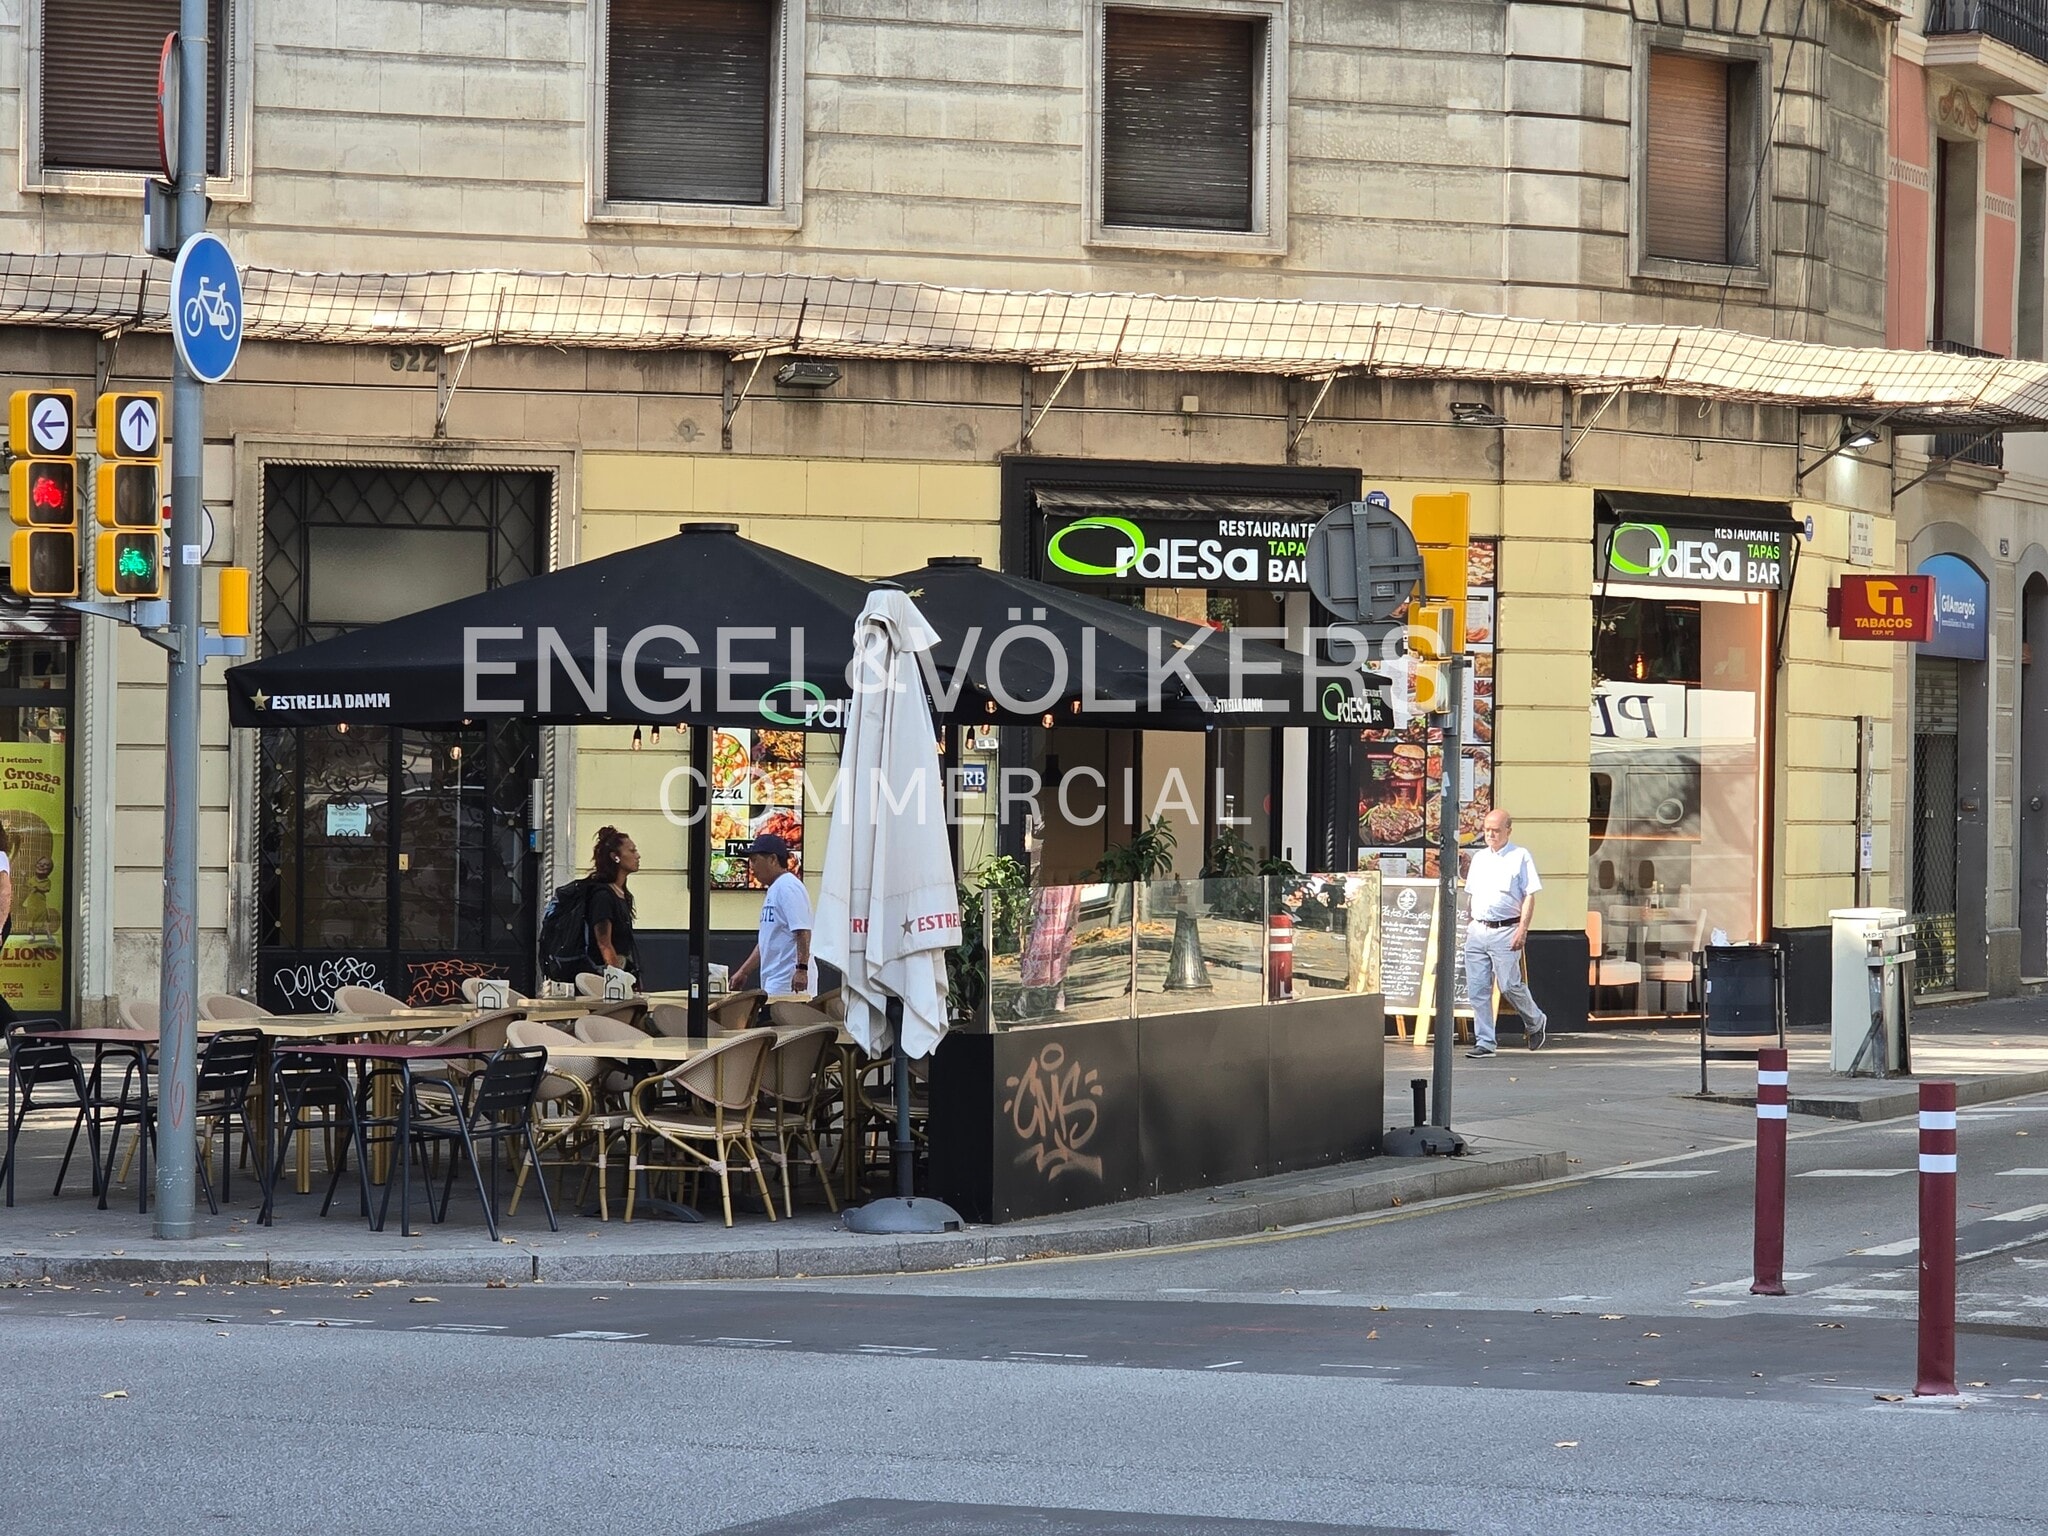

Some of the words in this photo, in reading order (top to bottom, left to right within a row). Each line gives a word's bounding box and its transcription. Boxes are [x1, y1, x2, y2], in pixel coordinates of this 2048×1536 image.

[389, 345, 437, 372] 522
[1715, 527, 1781, 543] RESTAURANTE
[1268, 541, 1307, 557] TAPA
[1747, 543, 1780, 560] TAPAS
[1747, 562, 1780, 585] BAR
[1854, 617, 1913, 629] TABACOS
[272, 694, 343, 710] ESTRELLA
[345, 693, 391, 709] DAMM
[6, 756, 43, 764] setembre
[4, 767, 62, 786] Grossa
[4, 781, 19, 790] La
[21, 780, 55, 794] Diada
[711, 787, 743, 800] izza
